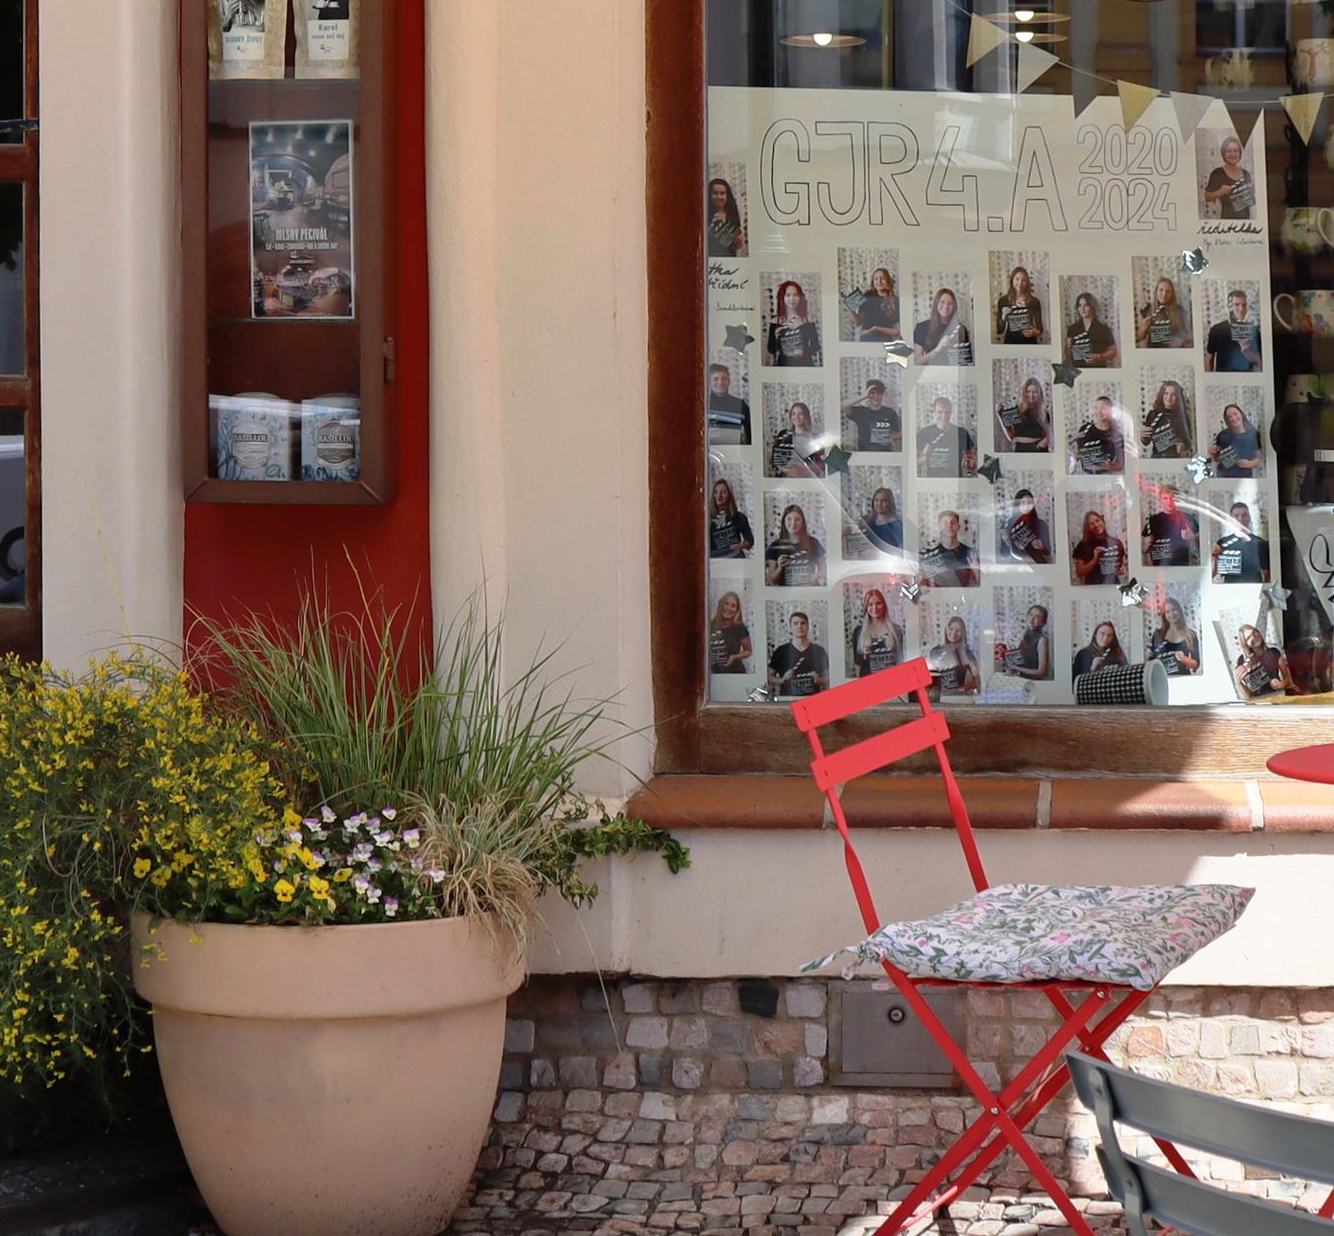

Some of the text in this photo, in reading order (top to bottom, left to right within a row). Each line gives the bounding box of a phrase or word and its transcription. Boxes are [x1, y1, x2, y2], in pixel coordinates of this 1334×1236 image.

[759, 117, 1068, 233] GJR 4.A
[1076, 123, 1180, 176] 2020
[1076, 178, 1178, 231] 2024
